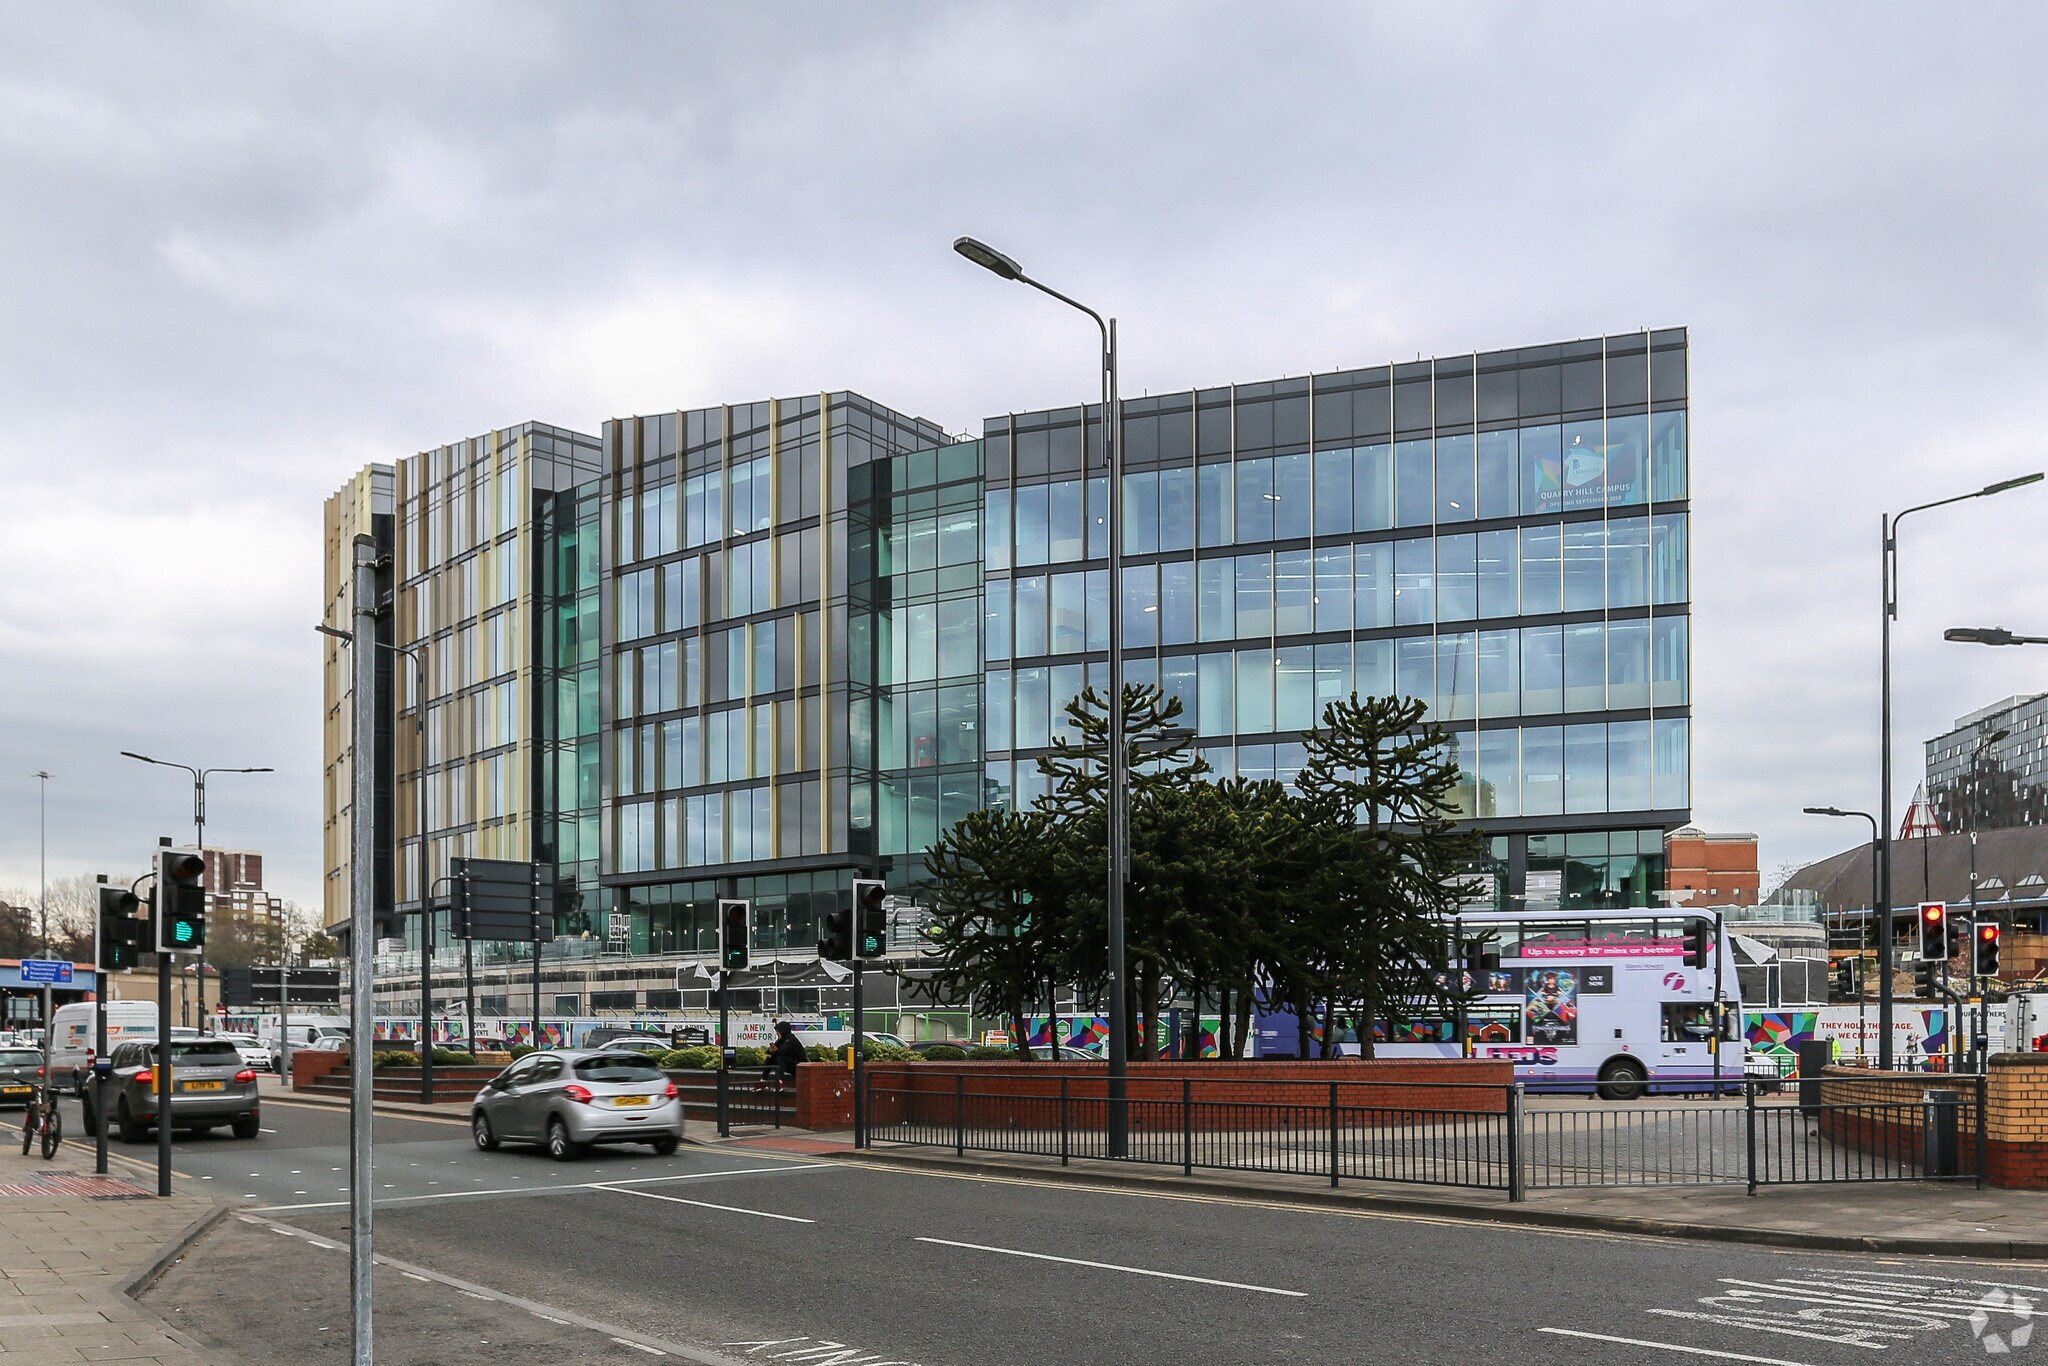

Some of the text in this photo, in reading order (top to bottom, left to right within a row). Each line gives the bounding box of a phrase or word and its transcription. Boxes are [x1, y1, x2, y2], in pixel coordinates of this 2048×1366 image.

[1576, 487, 1594, 496] HILL
[1549, 499, 1575, 508] OPEING
[1576, 497, 1605, 505] SEPTEMBE
[1527, 948, 1543, 957] Up
[1557, 949, 1586, 957] every
[1604, 946, 1629, 954] mins
[1643, 946, 1676, 954] better
[743, 1024, 766, 1032] A NEW
[1821, 1022, 1842, 1030] THEY
[1844, 1022, 1866, 1030] HOL
[1892, 1022, 1913, 1030] TAGE.
[473, 1029, 488, 1037] VENTS
[737, 1033, 773, 1041] HOME FOR
[1838, 1032, 1880, 1040] WE CEAT
